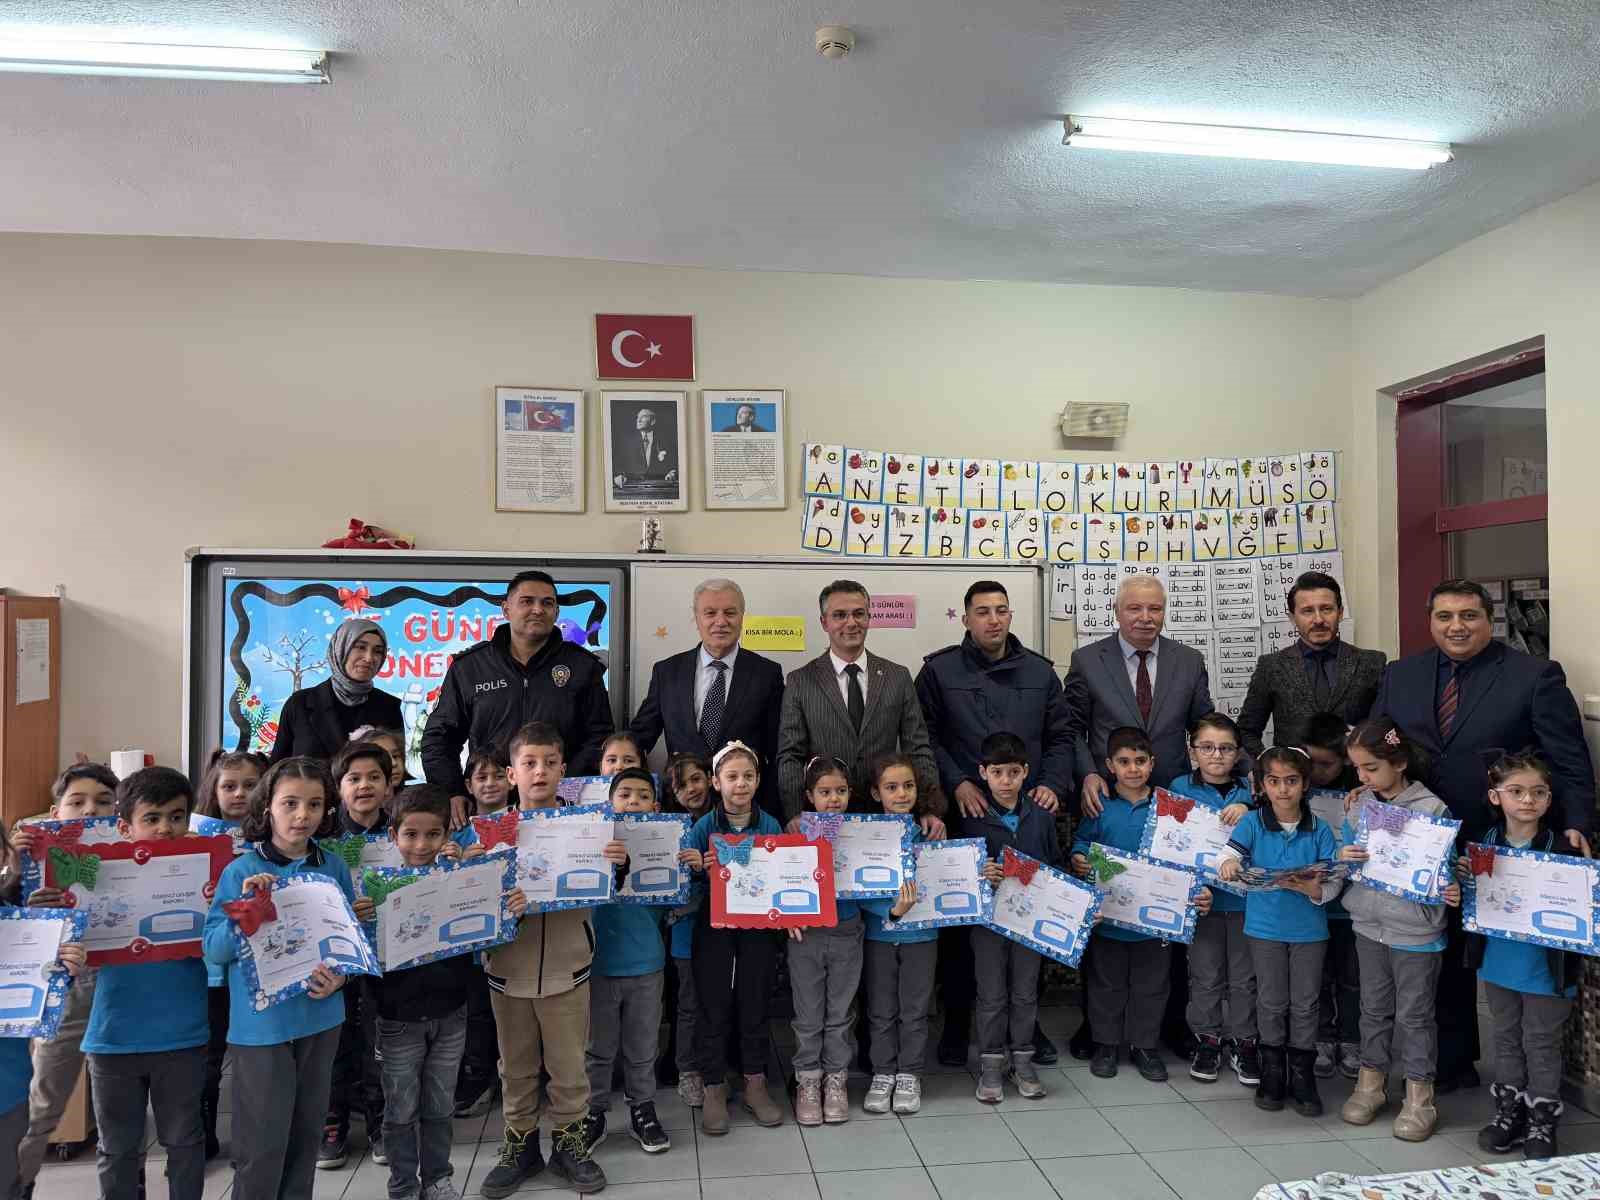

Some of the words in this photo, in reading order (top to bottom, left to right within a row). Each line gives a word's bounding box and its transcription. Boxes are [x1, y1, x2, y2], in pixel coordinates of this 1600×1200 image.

[828, 452, 836, 461] a
[869, 459, 877, 468] n
[1321, 456, 1329, 468] ö
[907, 463, 914, 471] e
[948, 460, 954, 475] t
[1102, 464, 1108, 480] k
[1169, 471, 1175, 479] r
[1226, 467, 1236, 476] m
[1259, 462, 1267, 473] ü
[1290, 463, 1296, 471] s
[815, 472, 832, 493] A
[1061, 471, 1069, 480] o
[1137, 472, 1145, 480] u
[854, 479, 871, 500] N
[896, 483, 908, 504] E
[936, 487, 949, 507] T
[1210, 487, 1231, 507] M
[1250, 480, 1265, 506] Ü
[1283, 483, 1294, 504] S
[1014, 490, 1026, 510] L
[1046, 491, 1066, 512] O
[1091, 492, 1105, 513] K
[1125, 491, 1140, 512] U
[1160, 491, 1170, 511] R
[830, 501, 840, 517] d
[953, 508, 961, 524] b
[1284, 507, 1290, 524] f
[1321, 506, 1326, 524] j
[871, 514, 880, 528] y
[912, 515, 919, 523] z
[1029, 517, 1037, 533] g
[1070, 521, 1078, 529] c
[1180, 514, 1187, 529] h
[1214, 517, 1222, 525] v
[1250, 512, 1258, 530] ğ
[1147, 521, 1154, 536] p
[816, 527, 832, 548] D
[859, 533, 874, 554] Y
[899, 534, 914, 554] Z
[1238, 531, 1257, 556] Ğ
[1277, 533, 1288, 553] F
[1313, 530, 1323, 550] J
[940, 536, 953, 556] B
[1017, 538, 1037, 558] G
[1057, 541, 1074, 562] C
[1138, 541, 1149, 561] P
[1168, 541, 1183, 561] H
[1203, 537, 1220, 557] V
[1125, 567, 1138, 577] ap
[1146, 567, 1160, 577] ep
[1260, 560, 1272, 570] ba
[1081, 568, 1096, 581] da
[1103, 567, 1116, 580] de
[1264, 572, 1272, 585] bi
[1280, 572, 1293, 584] bo
[1084, 582, 1094, 595] di
[1264, 588, 1276, 601] bu
[1083, 598, 1097, 611] du
[1084, 614, 1097, 627] dü
